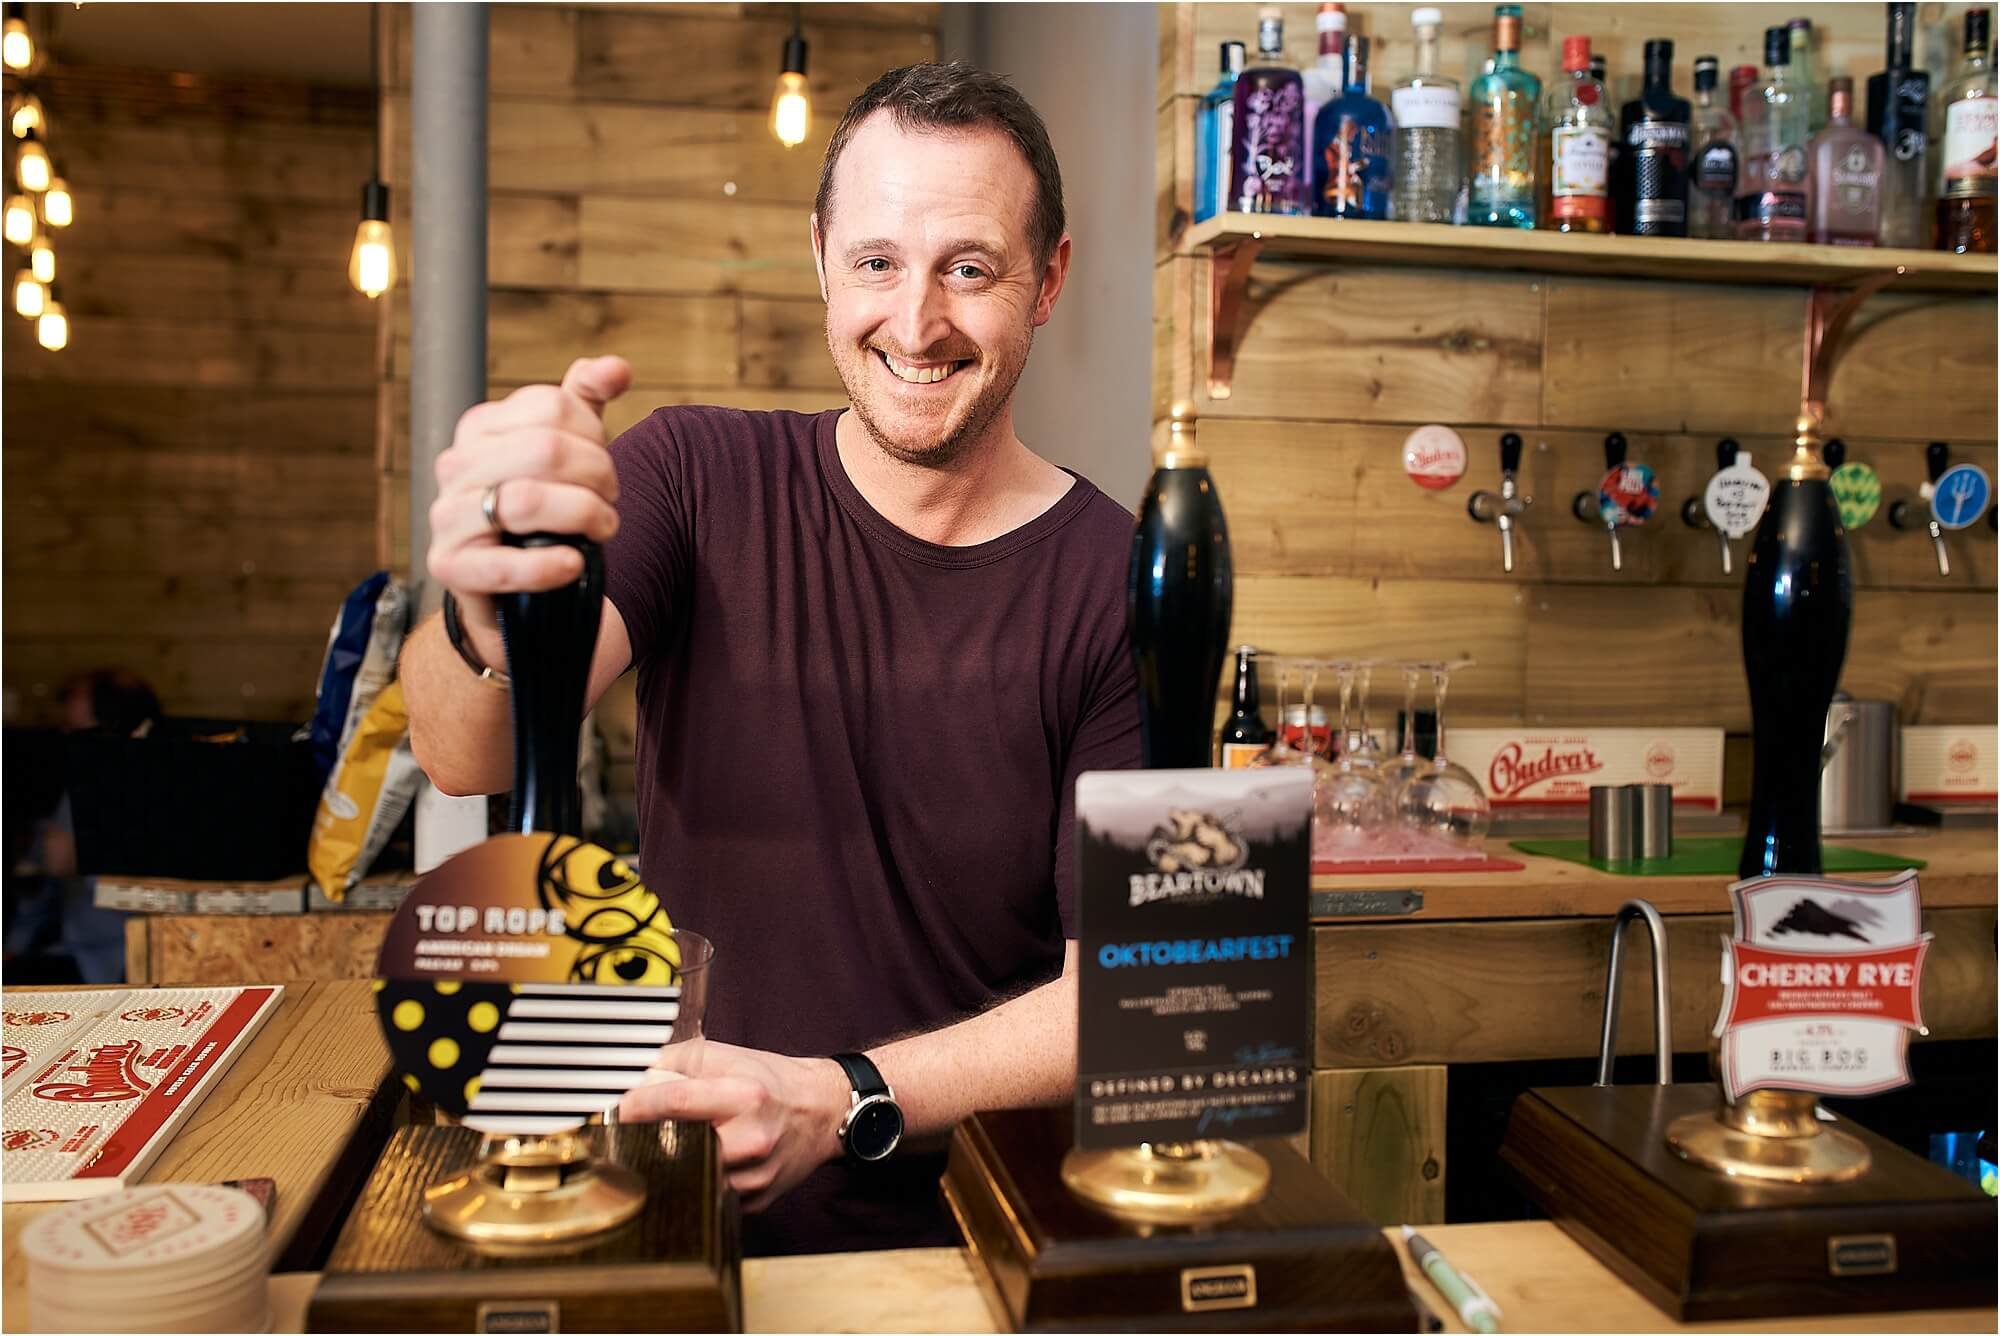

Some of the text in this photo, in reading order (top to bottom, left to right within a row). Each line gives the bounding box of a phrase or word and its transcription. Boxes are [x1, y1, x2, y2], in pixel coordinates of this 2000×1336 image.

[1489, 741, 1604, 797] Budvar
[1128, 869, 1266, 907] BEARTOWN
[416, 905, 567, 935] TOP ROPE
[1098, 936, 1294, 968] OKTOBEARFEST
[1740, 962, 1914, 988] CHERRY RYE
[1768, 1047, 1811, 1065] BIG
[1091, 1067, 1297, 1098] DEFINED BY DECADES
